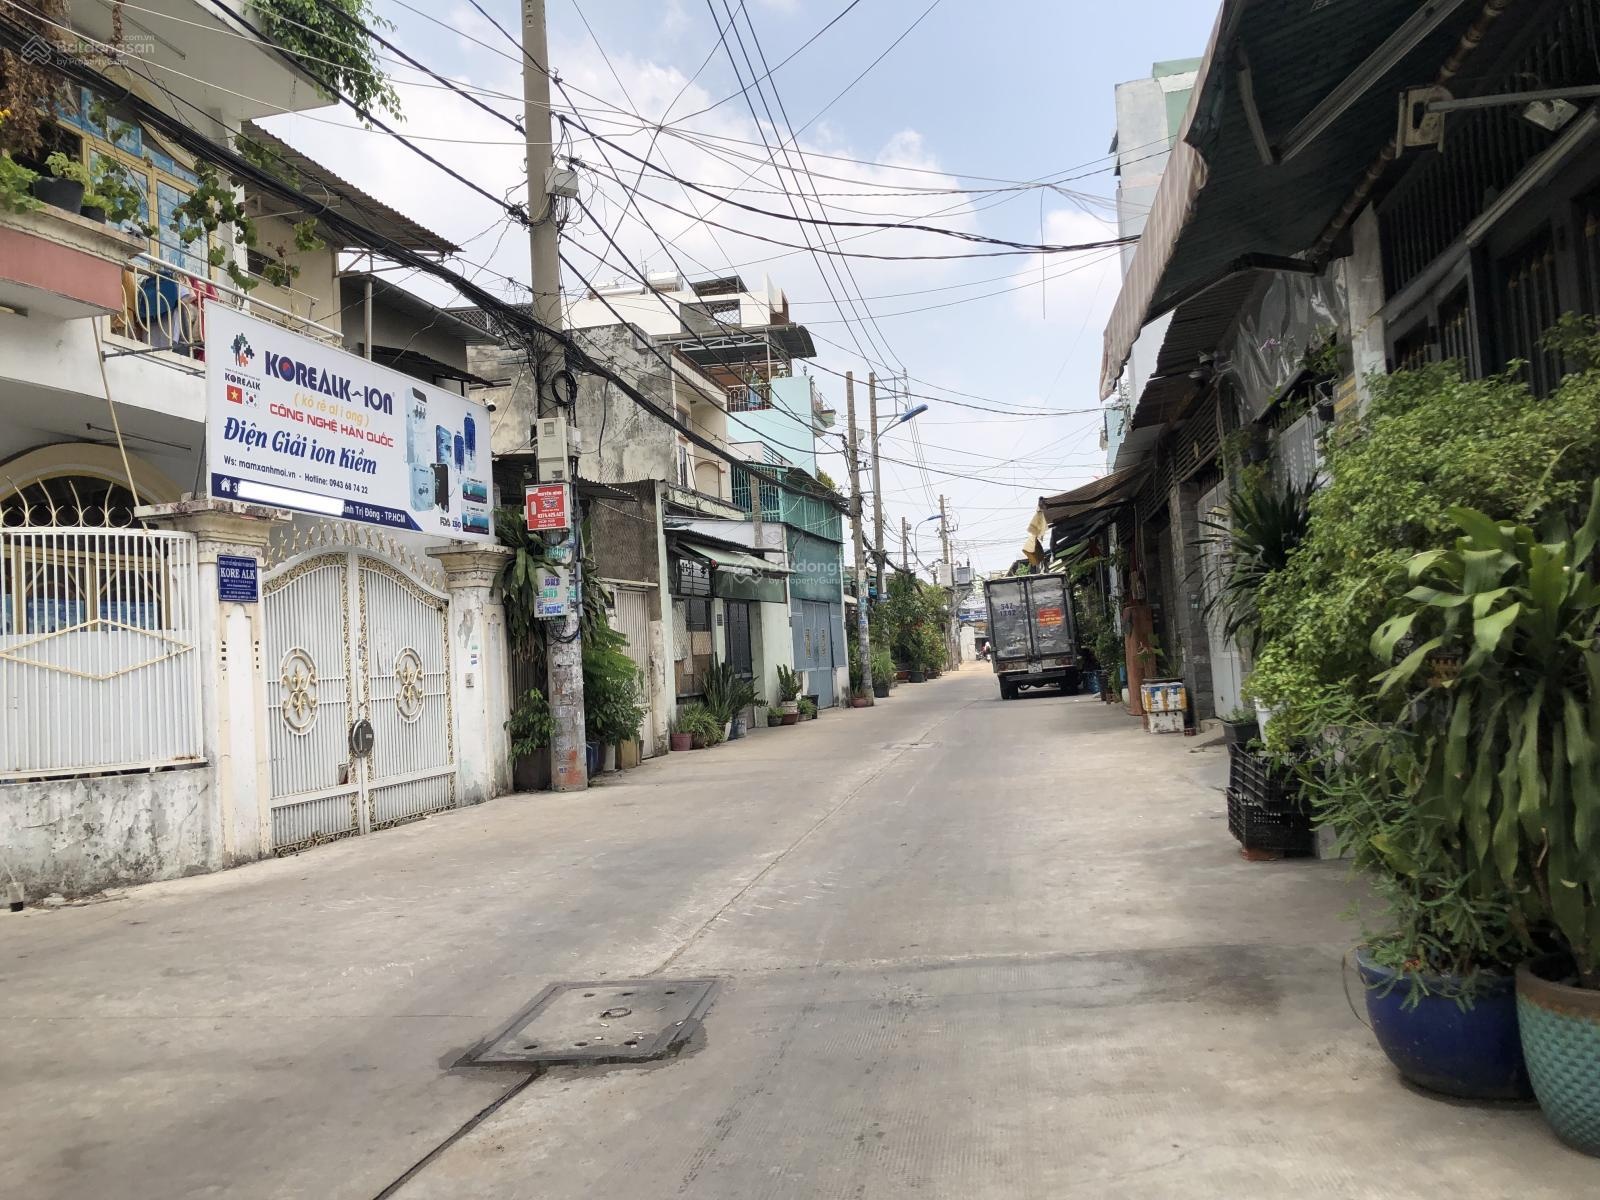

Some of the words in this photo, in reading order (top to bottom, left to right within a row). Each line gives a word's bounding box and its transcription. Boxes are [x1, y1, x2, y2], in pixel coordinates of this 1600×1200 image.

[225, 373, 261, 391] KOREALK
[270, 403, 304, 422] CÔNG
[307, 414, 338, 434] NGHỆ
[340, 424, 364, 440] HÀN
[366, 432, 394, 448] QUỐC
[223, 417, 268, 452] Điện
[272, 430, 308, 458] Giải
[310, 439, 335, 465] ion
[339, 447, 377, 475] Kiềm
[224, 455, 237, 467] Ws:
[238, 460, 296, 479] mamxanhmoi.vn
[304, 473, 328, 487] Hotline:
[329, 478, 344, 490] 0943
[345, 482, 352, 492] 68
[353, 484, 360, 493] 74
[361, 486, 369, 495] 22
[384, 511, 406, 524] TP.HCM
[220, 567, 241, 579] KORE
[241, 569, 256, 580] ALK
